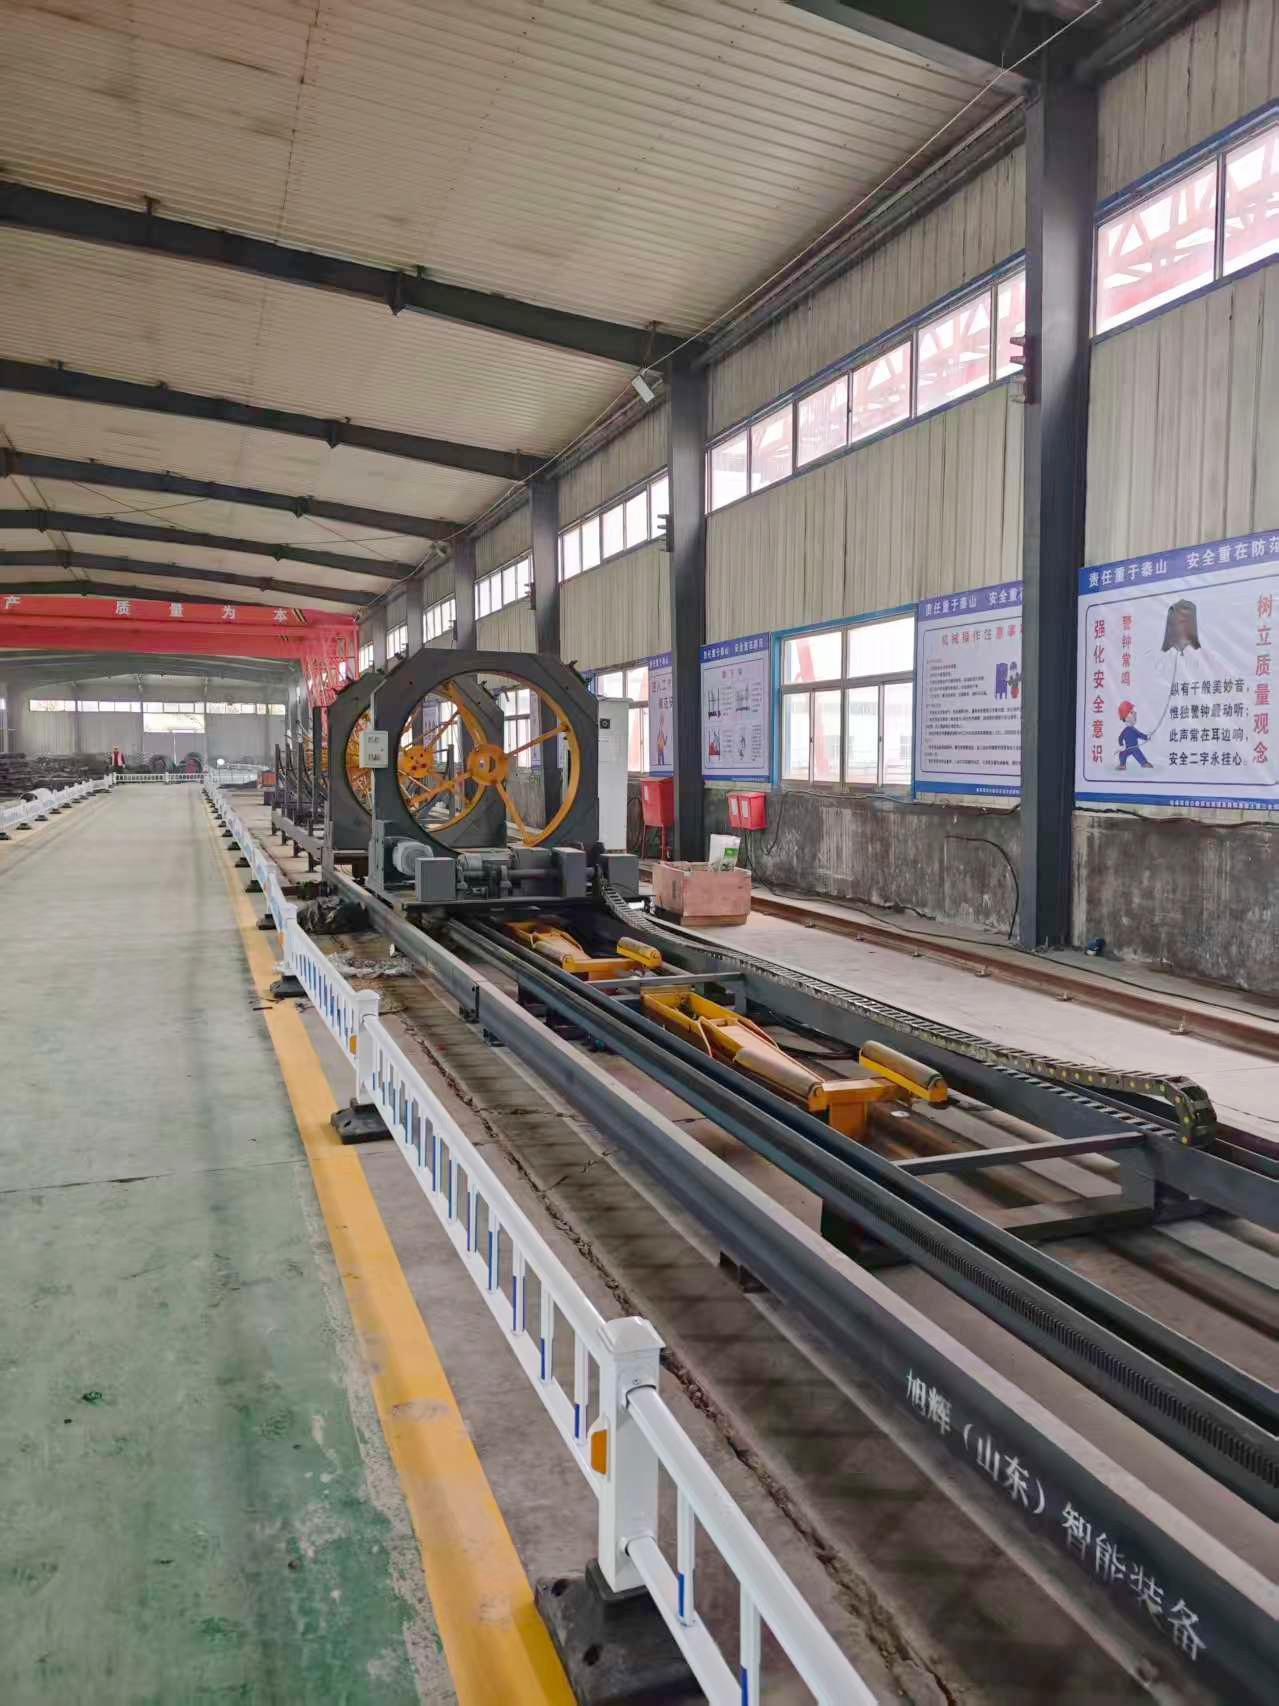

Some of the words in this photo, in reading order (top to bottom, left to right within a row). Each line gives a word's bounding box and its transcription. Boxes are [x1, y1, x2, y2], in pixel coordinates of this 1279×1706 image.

[1087, 558, 1168, 588] 责任重于泰山
[115, 600, 288, 622] 质量为本
[988, 587, 1023, 606] 安全重
[1091, 619, 1106, 764] 强化安全意识
[1252, 593, 1273, 765] 树立质量观念
